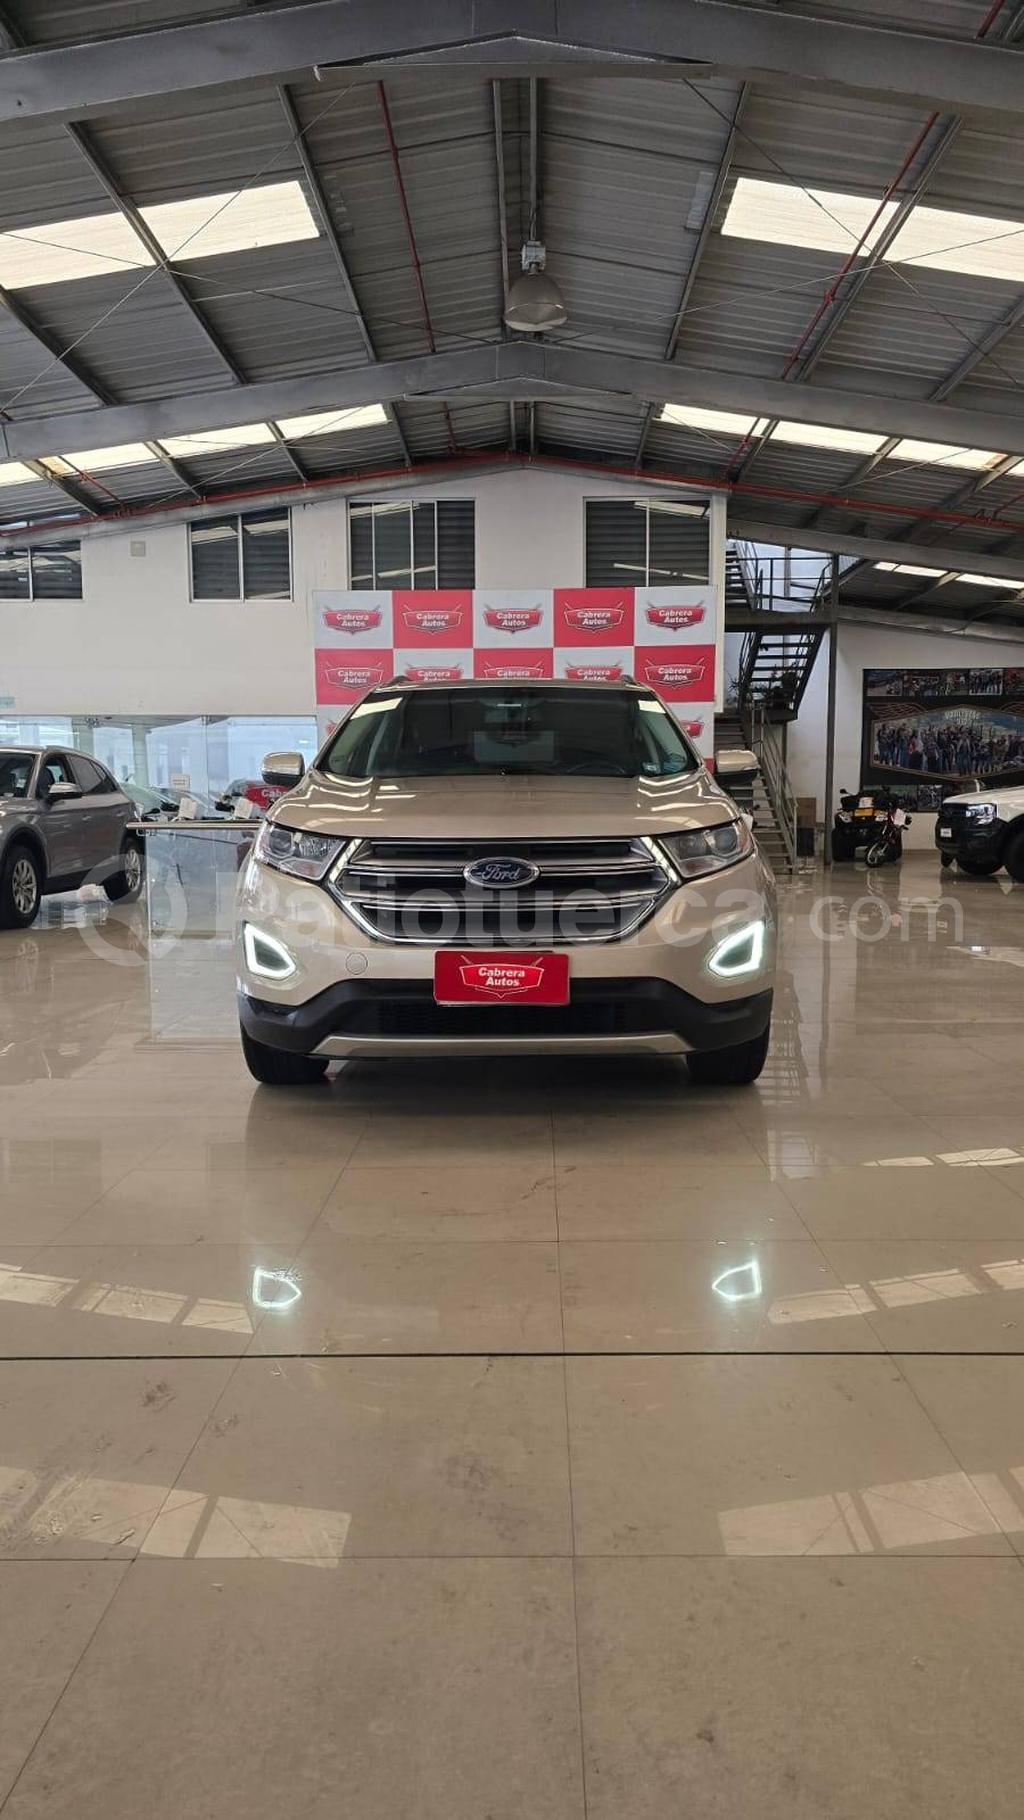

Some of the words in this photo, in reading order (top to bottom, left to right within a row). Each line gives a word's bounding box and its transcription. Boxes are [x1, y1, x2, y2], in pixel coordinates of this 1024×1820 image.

[336, 613, 369, 621] Cabrera
[496, 612, 530, 620] Cabrera
[577, 611, 611, 619] Cabrera
[659, 609, 693, 617] Cabrera
[501, 619, 526, 627] Autos
[582, 618, 607, 626] Autos
[664, 616, 689, 624] Autos
[337, 670, 371, 678] Cabrera
[496, 669, 530, 677] Cabrera
[577, 668, 611, 676] Cabrera
[658, 667, 692, 675] Cabrera
[343, 676, 368, 684] Autos
[477, 863, 523, 881] Ford
[478, 967, 525, 978] Cabrera
[485, 977, 520, 987] Autos
